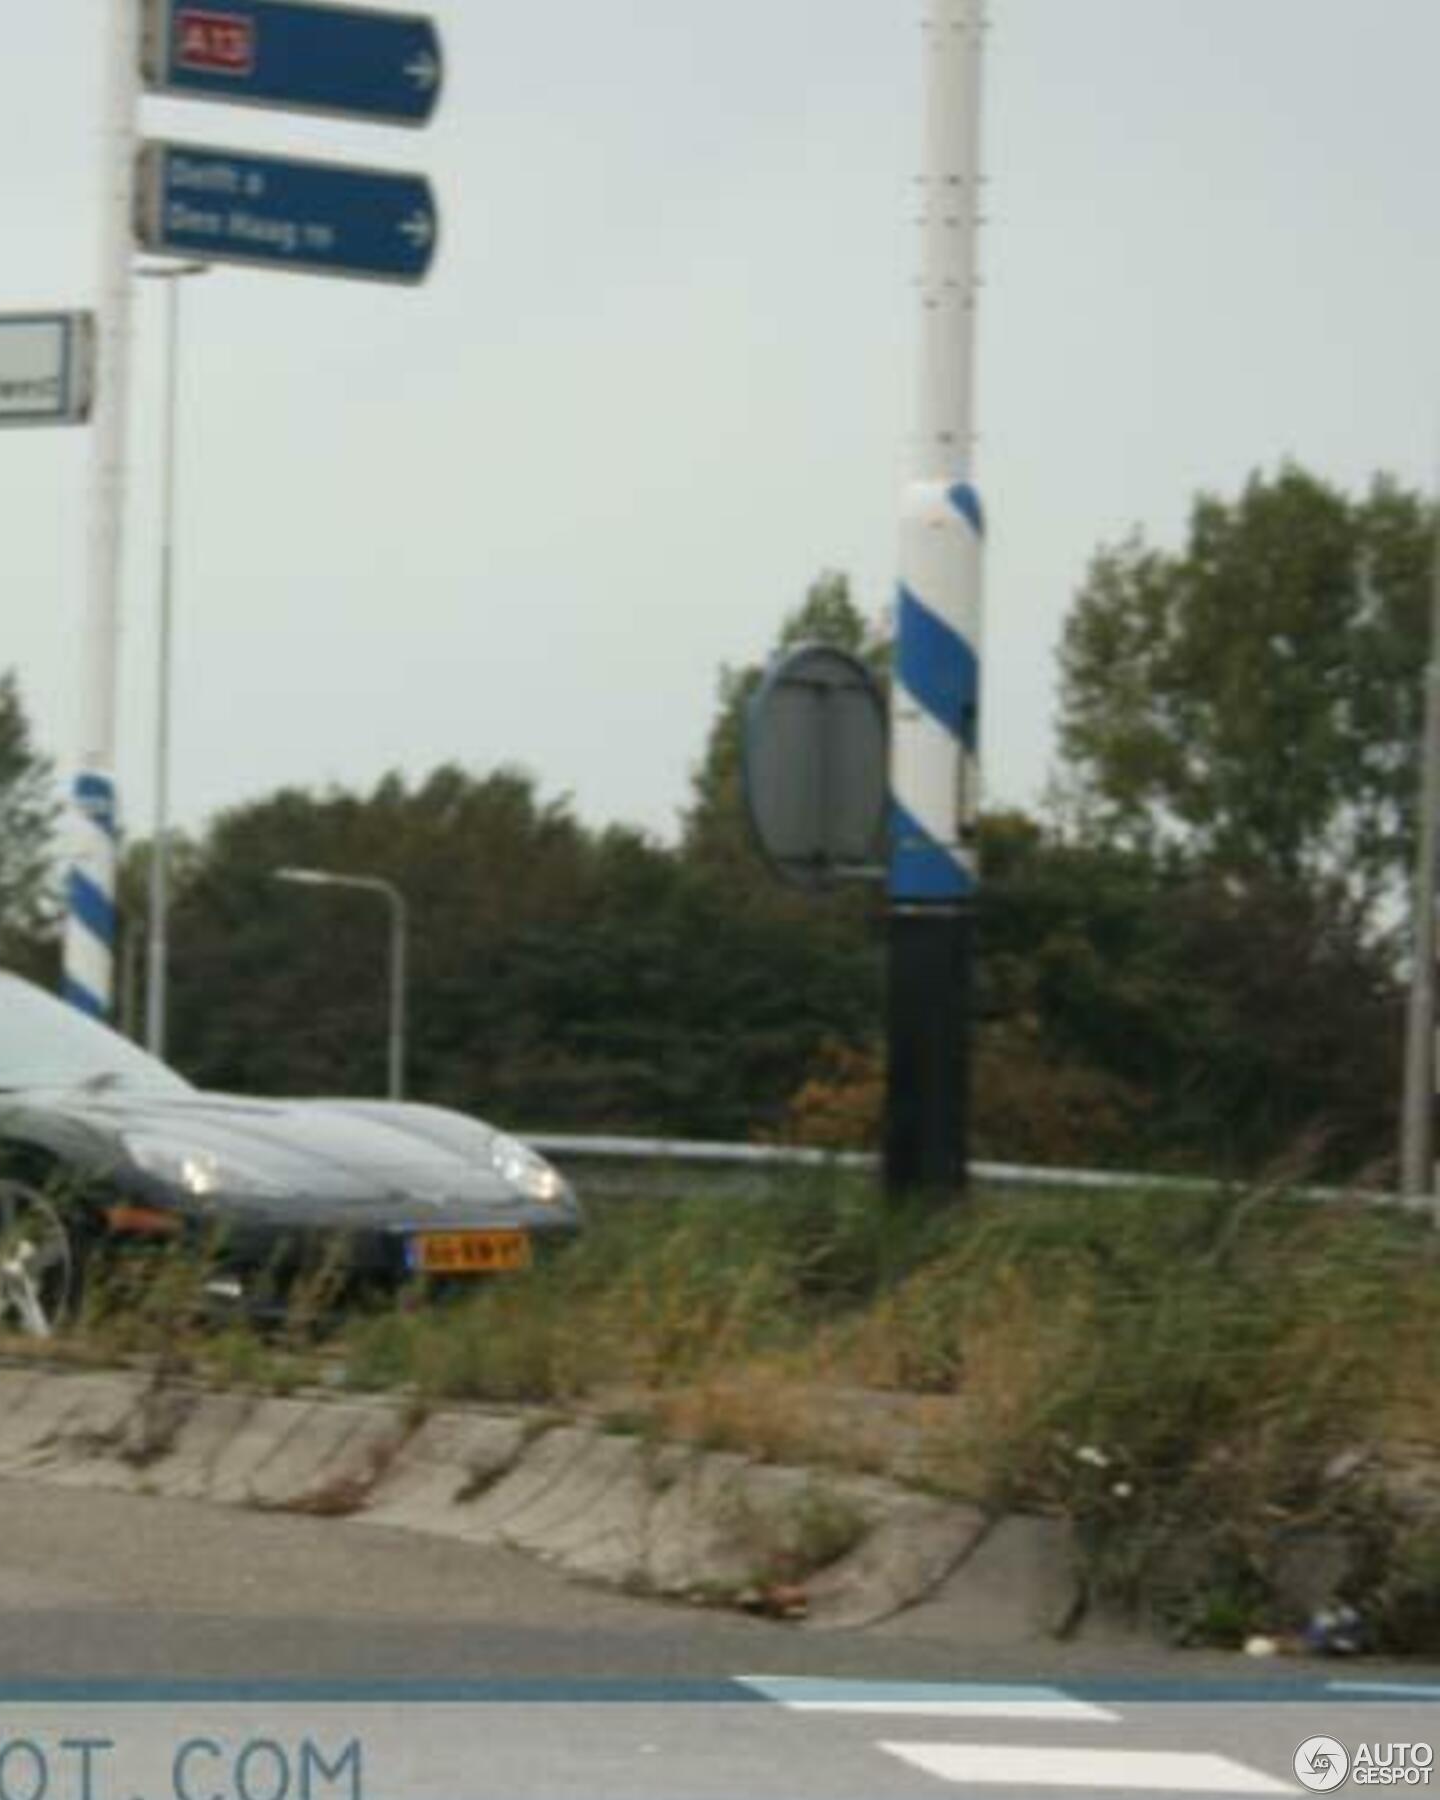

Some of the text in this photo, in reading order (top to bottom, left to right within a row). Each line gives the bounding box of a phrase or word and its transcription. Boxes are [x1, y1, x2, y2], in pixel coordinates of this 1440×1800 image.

[181, 23, 248, 62] A13
[171, 201, 221, 233] Den
[228, 209, 296, 252] Haag
